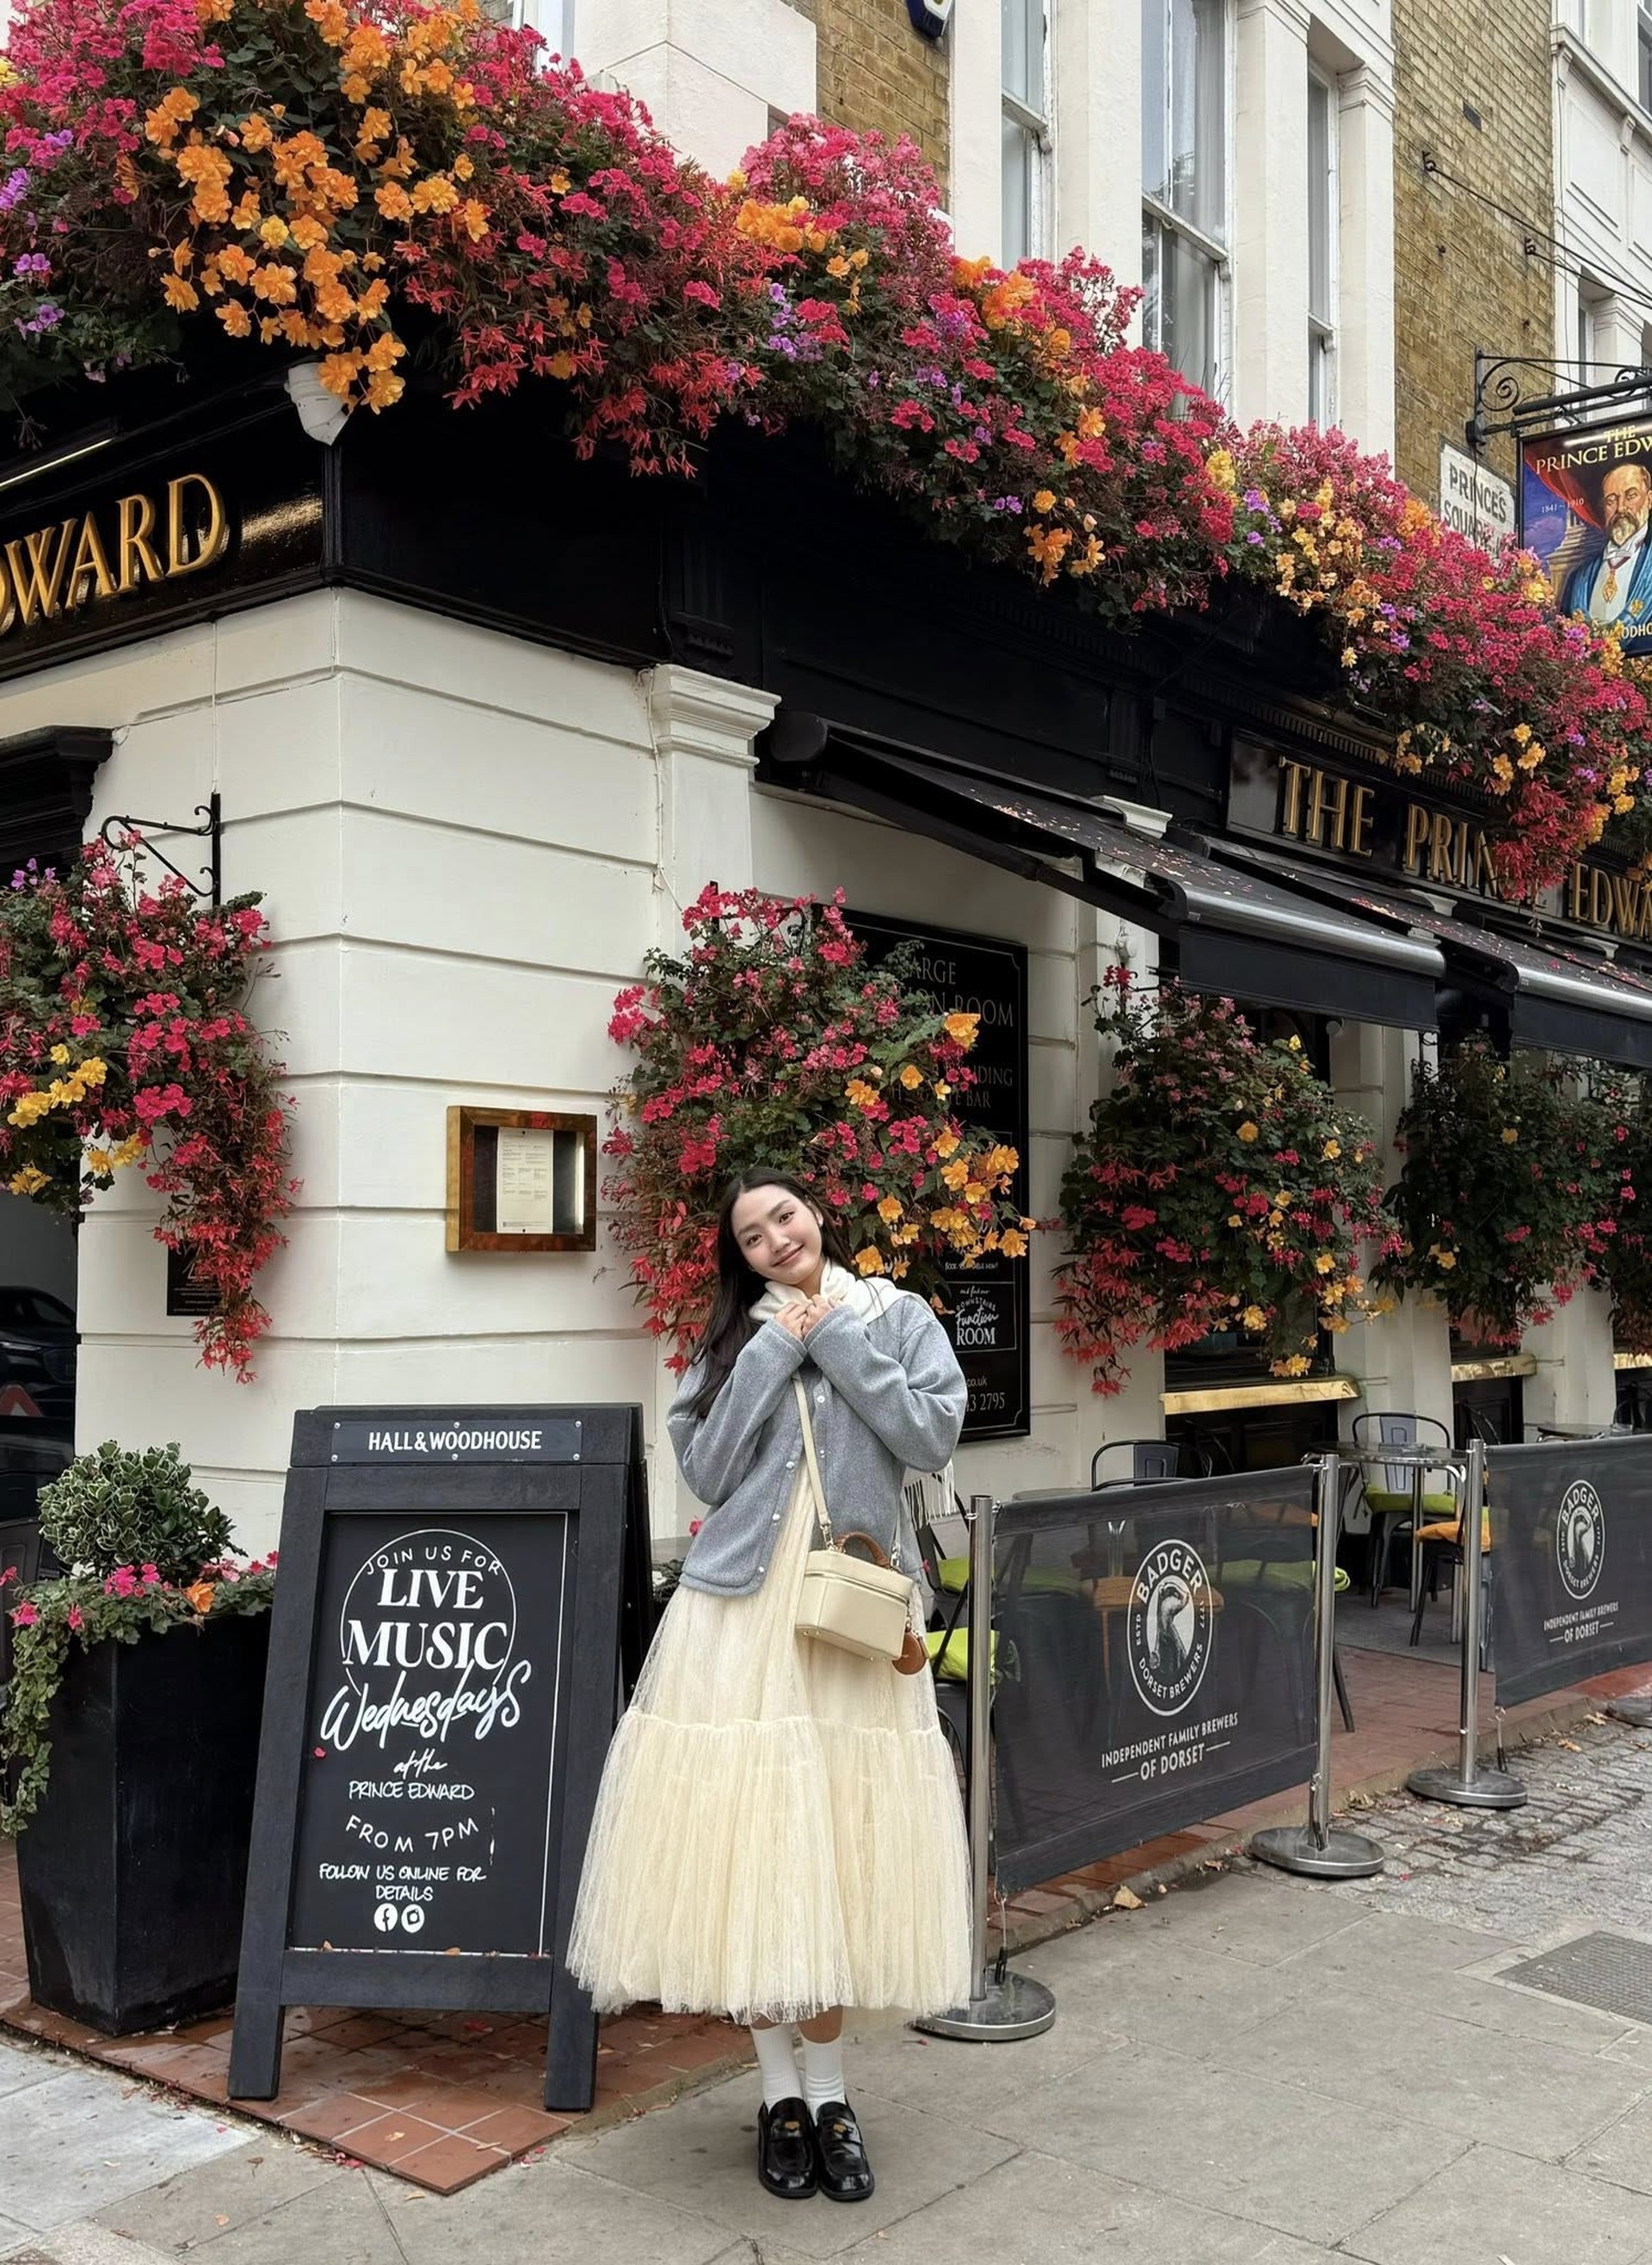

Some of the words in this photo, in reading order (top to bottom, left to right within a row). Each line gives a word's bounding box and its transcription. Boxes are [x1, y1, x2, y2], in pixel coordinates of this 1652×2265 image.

[1604, 425, 1636, 442] THE
[1536, 446, 1608, 474] PRINCE
[1541, 504, 1557, 513] 1841
[1567, 497, 1584, 509] 1910
[1444, 499, 1490, 545] SQUAR
[0, 473, 225, 626] WARD
[1279, 756, 1375, 856] THE
[1406, 804, 1504, 898] PRIN
[909, 956, 957, 985] ARGE
[955, 1305, 999, 1326] Function
[956, 1327, 996, 1345] ROOM
[980, 1392, 1005, 1410] 2795
[1562, 1486, 1600, 1525] BADGER
[367, 1548, 414, 1575] JOIN
[425, 1546, 452, 1561] US
[461, 1550, 501, 1576] FOR
[1137, 1548, 1203, 1603] BADGER
[377, 1568, 484, 1609] LIVE
[342, 1620, 508, 1669] MUSIC
[1564, 1627, 1574, 1644] OF
[1139, 1657, 1168, 1699] DORSET
[1169, 1642, 1203, 1699] BREWERS
[1101, 1735, 1167, 1768] INDEPENDENT
[1168, 1724, 1200, 1747] FAMILY
[1202, 1712, 1238, 1736] BREWERS
[1140, 1759, 1157, 1781] OF
[1162, 1743, 1205, 1774] DORSET
[348, 1781, 404, 1799] PRINCE
[407, 1782, 475, 1799] EDWARD
[345, 1815, 413, 1853] FROM
[424, 1818, 478, 1850] 7PM
[319, 1862, 370, 1879] FOLLOW
[376, 1866, 395, 1880] US
[398, 1866, 450, 1880] ONLINE
[457, 1867, 487, 1882] FOR
[375, 1885, 434, 1901] DETAILS
